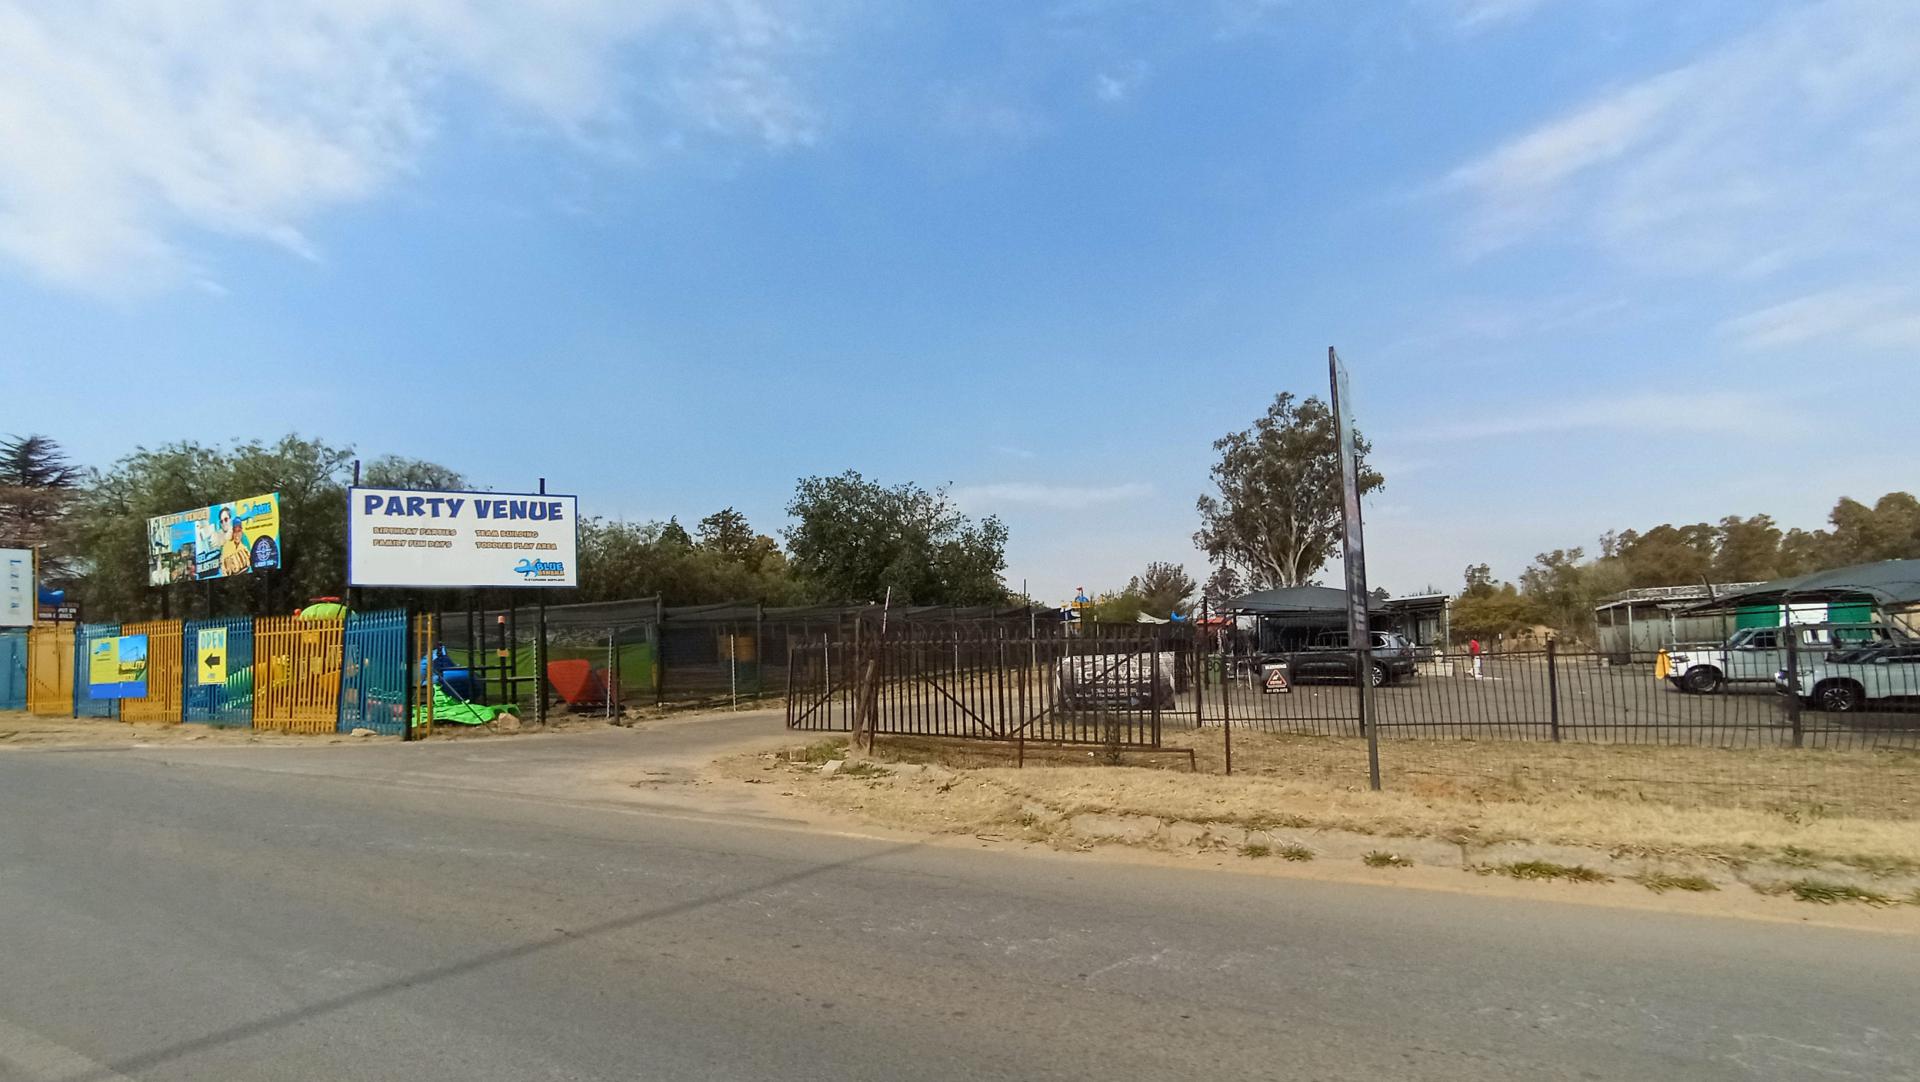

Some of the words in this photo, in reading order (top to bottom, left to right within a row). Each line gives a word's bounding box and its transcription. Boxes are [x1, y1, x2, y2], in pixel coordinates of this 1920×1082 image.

[364, 494, 465, 518] PARTY
[473, 498, 564, 522] VENUE
[373, 527, 418, 535] BIRTHDAY
[419, 528, 457, 536] PARTIES
[500, 530, 539, 538] BUILDING
[373, 539, 407, 547] FAMILY
[535, 561, 564, 572] BLUE
[201, 631, 225, 649] OPEN
